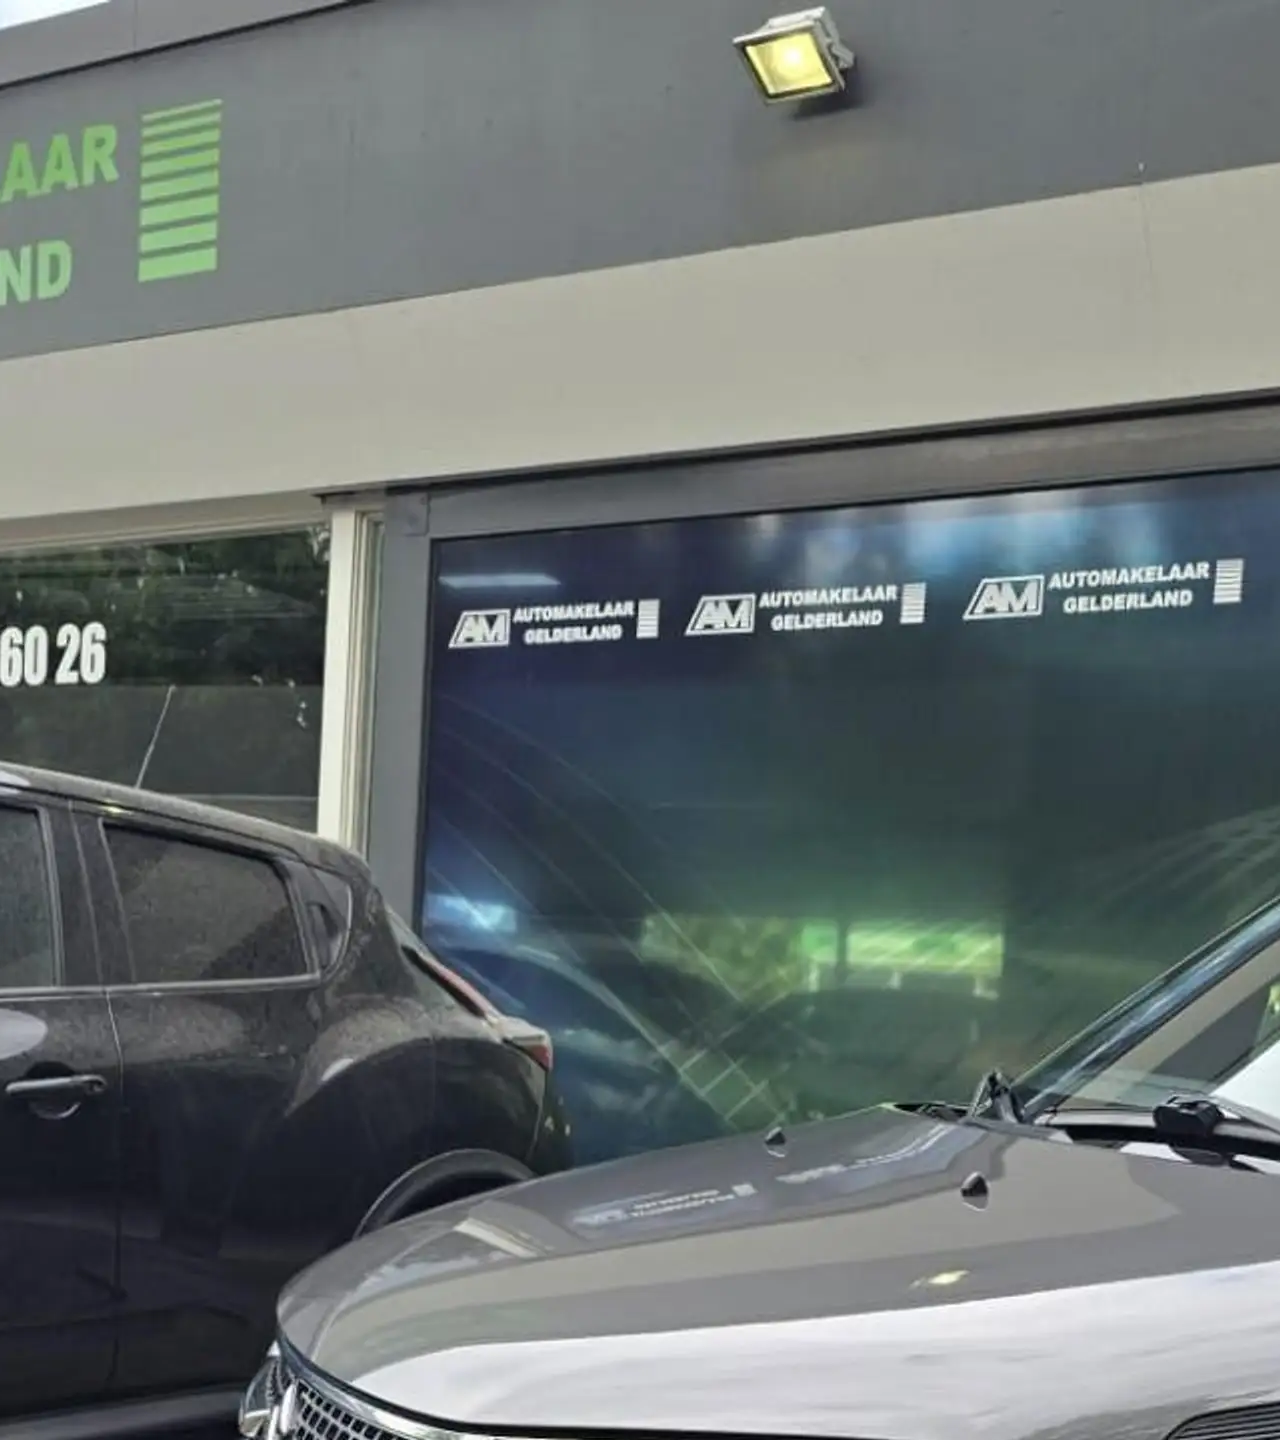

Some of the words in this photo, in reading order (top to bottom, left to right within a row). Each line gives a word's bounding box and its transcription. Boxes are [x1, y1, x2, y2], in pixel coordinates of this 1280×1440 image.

[1048, 561, 1210, 590] AUTOMAKELAAR
[759, 585, 898, 608] AUTOMAKELAAR
[1063, 589, 1193, 614] GELDERLAND
[513, 601, 635, 623] AUTOMAKELAAR
[771, 610, 884, 631] GELDERLAND
[524, 624, 623, 645] GELDERLAND
[55, 621, 107, 685] 26
